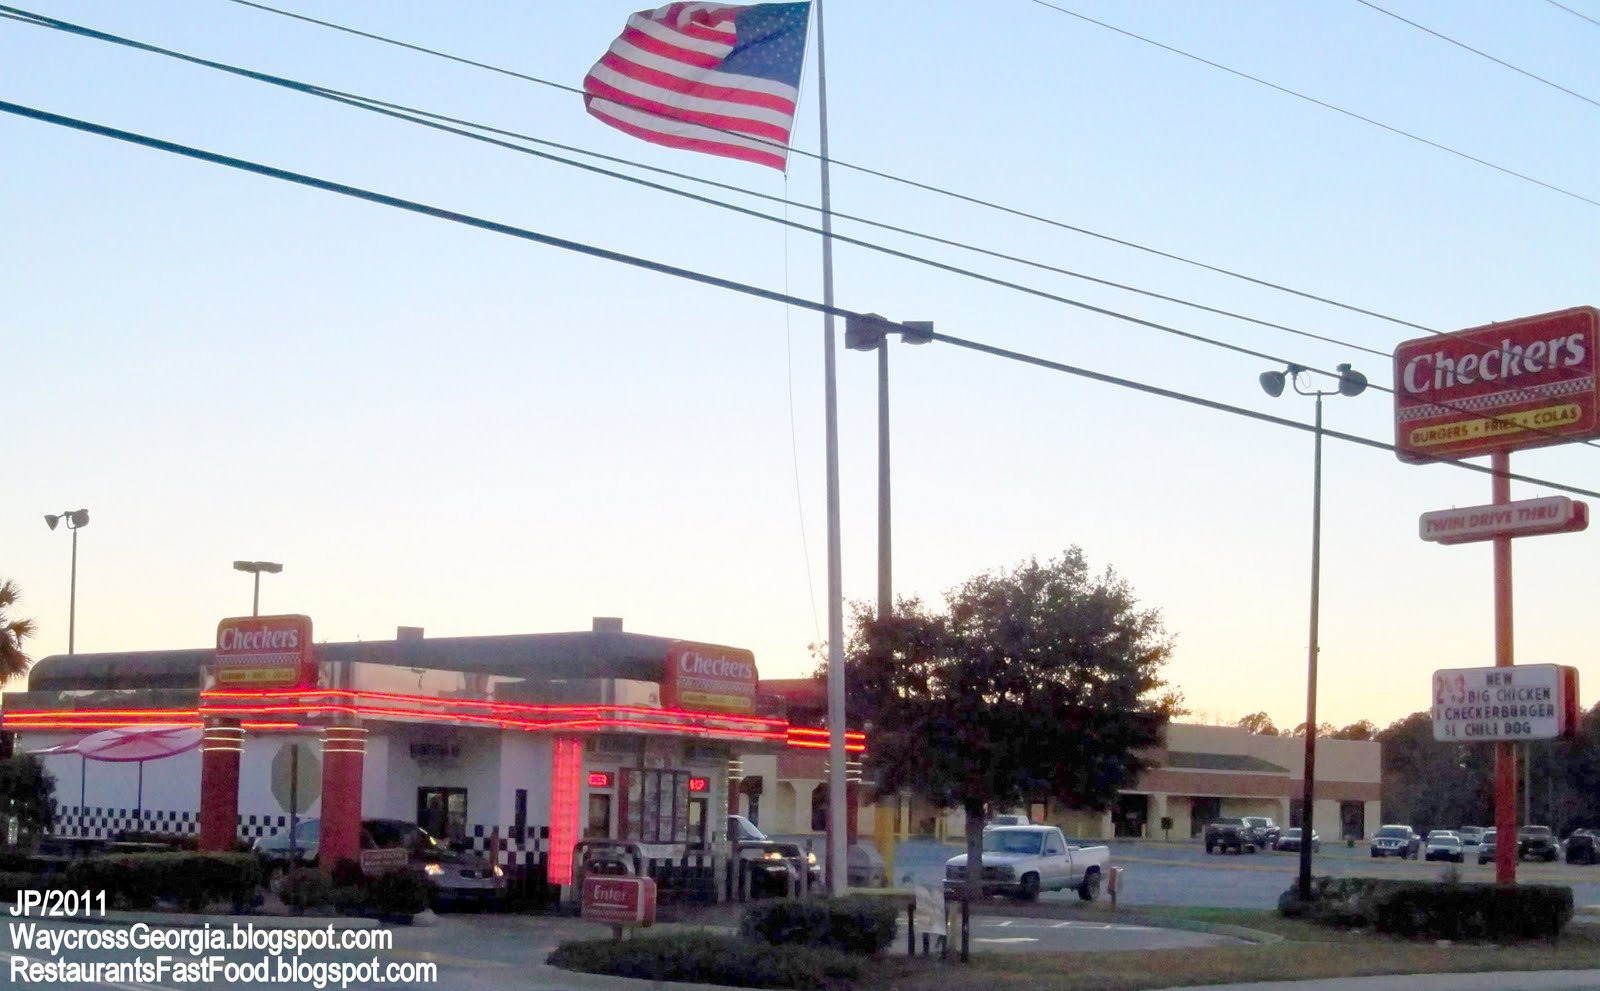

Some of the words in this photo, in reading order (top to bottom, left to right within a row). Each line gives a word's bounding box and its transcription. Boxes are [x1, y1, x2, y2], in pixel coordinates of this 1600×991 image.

[1403, 333, 1585, 394] Checkers
[1412, 425, 1468, 444] BURGERS
[1484, 417, 1518, 432] FRIES
[1533, 407, 1578, 425] COLAS
[1426, 515, 1465, 533] TWIN
[1469, 510, 1513, 527] DRIVE
[1518, 503, 1560, 522] THRU
[220, 626, 299, 651] Checkers
[680, 651, 753, 679] Checkers
[1486, 672, 1513, 686] NEW
[1468, 690, 1490, 703] BIG
[1497, 687, 1551, 702] CHICKEN
[1444, 704, 1554, 721] CHECKERBURGER
[1464, 722, 1498, 737] CHILI
[1504, 721, 1532, 734] DOG
[593, 884, 626, 901] Enter
